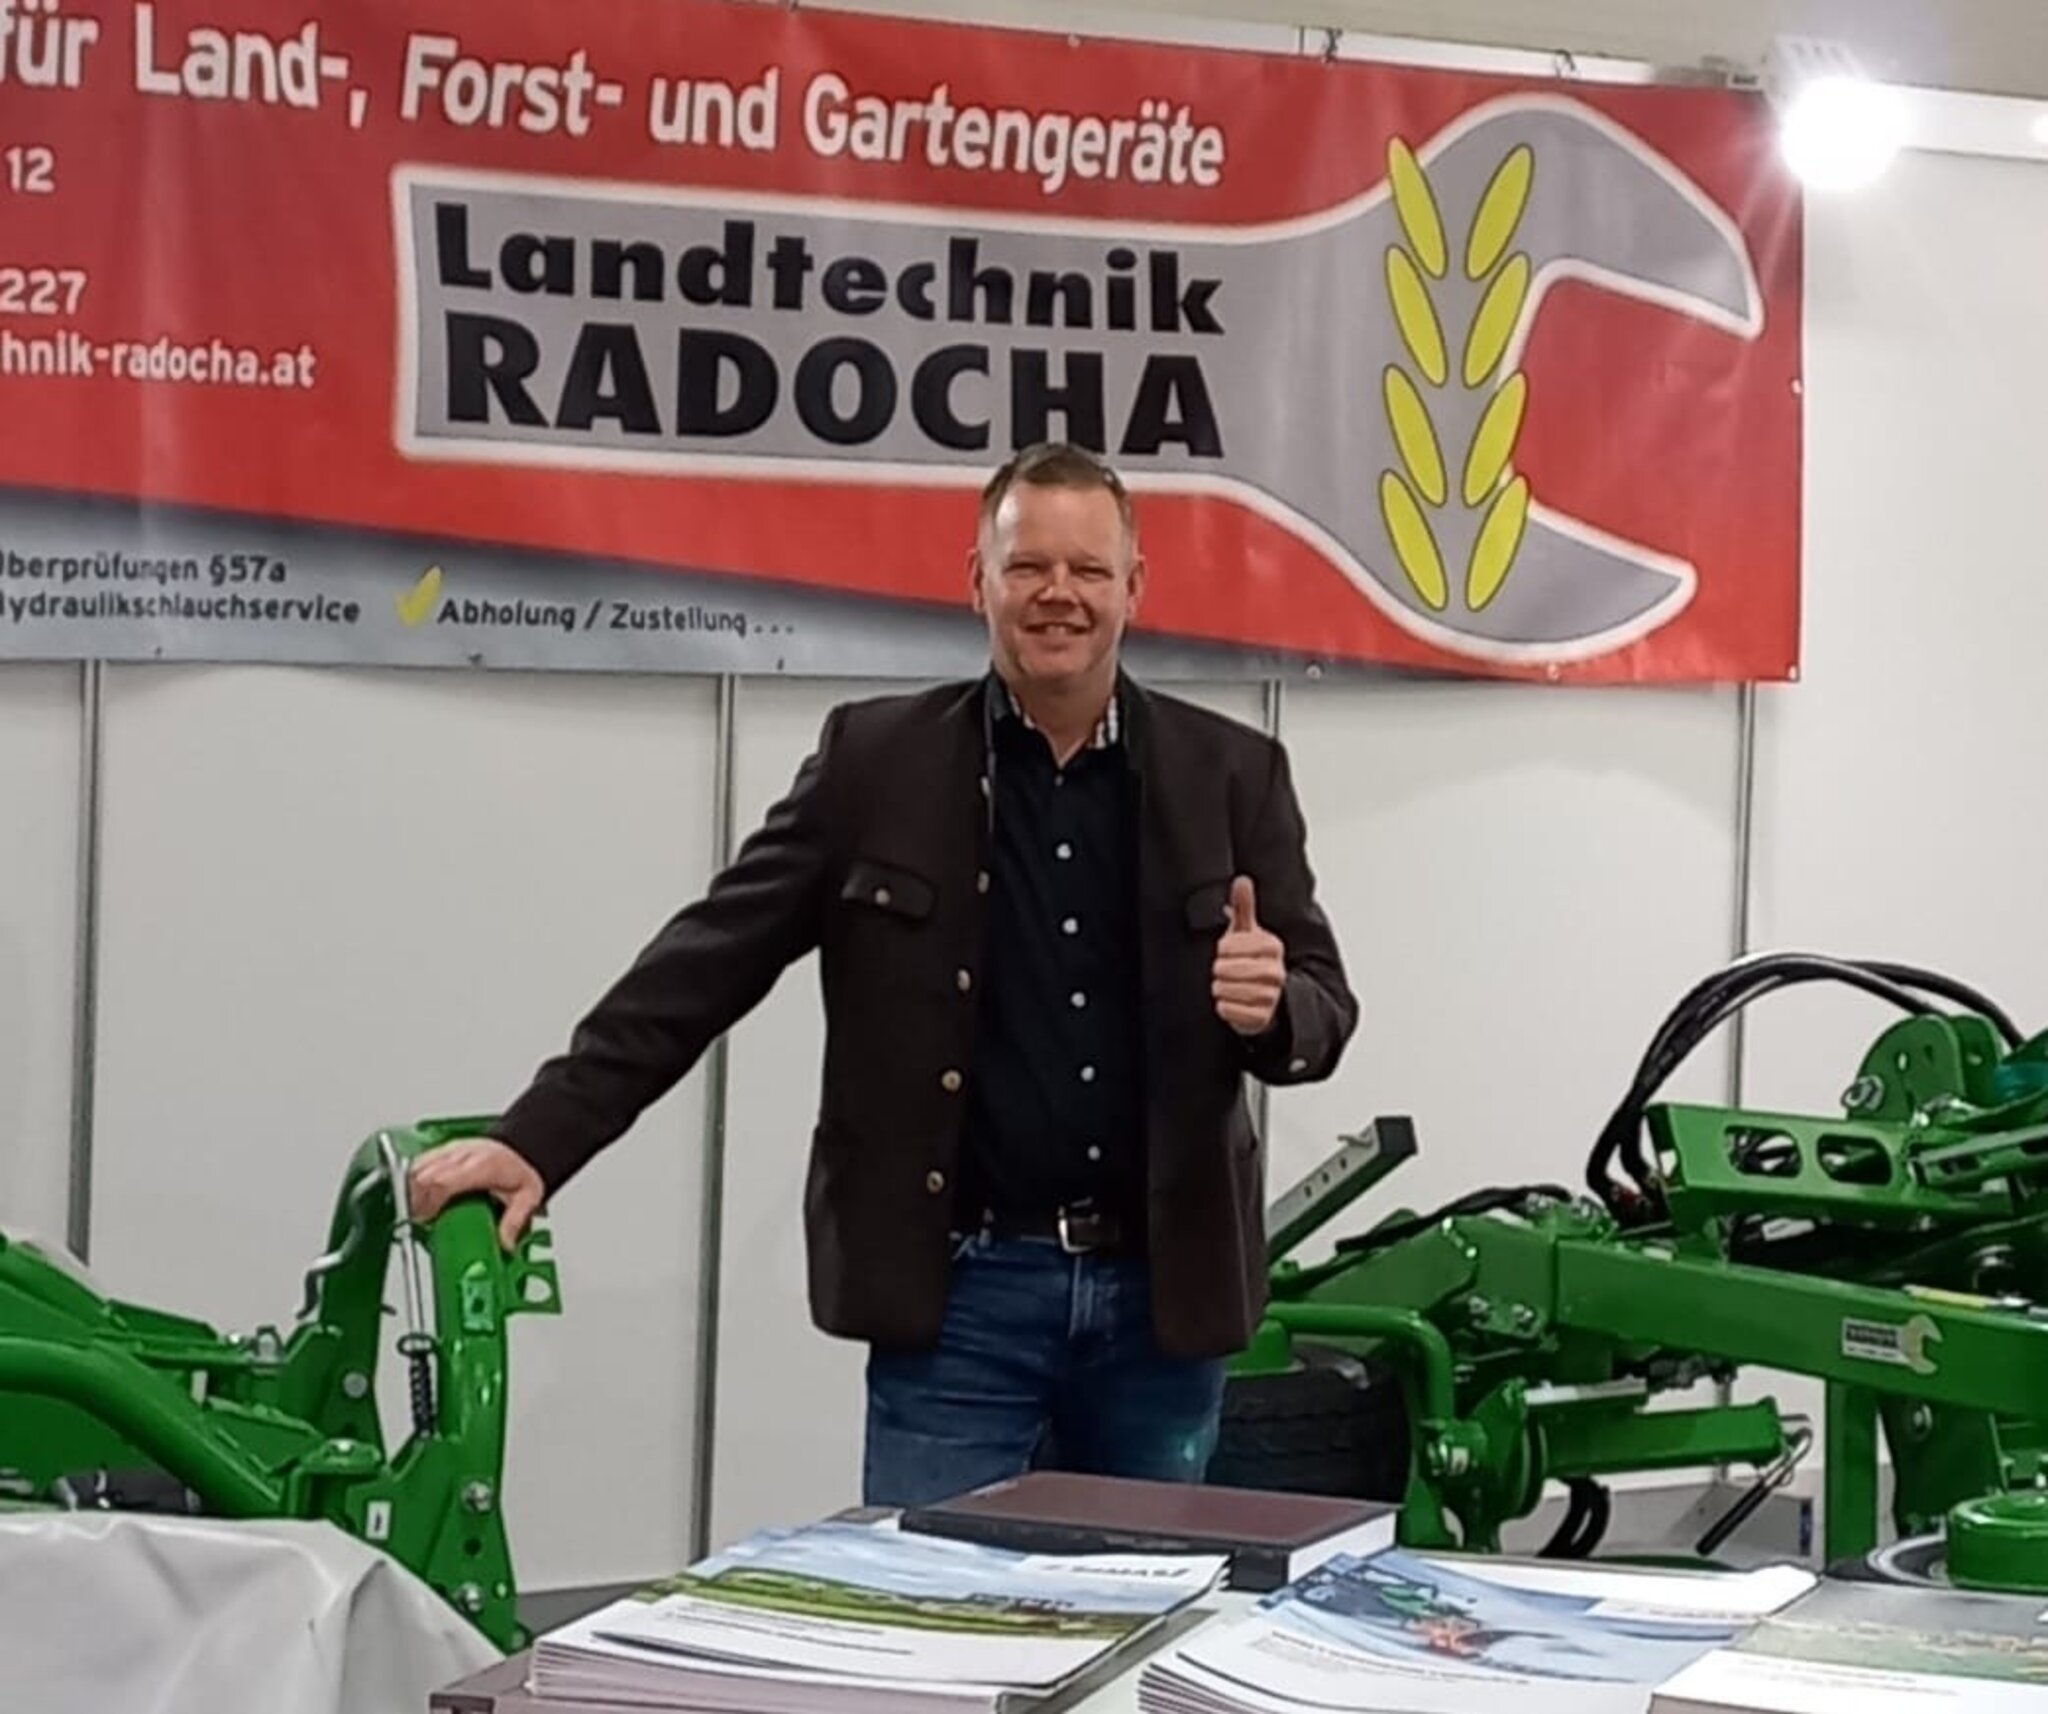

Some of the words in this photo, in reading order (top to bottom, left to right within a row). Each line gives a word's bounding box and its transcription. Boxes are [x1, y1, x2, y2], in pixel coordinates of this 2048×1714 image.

[136, 3, 367, 129] Land-,
[401, 34, 623, 136] Forst-
[649, 67, 780, 150] und
[804, 73, 1224, 193] Gartengeräte
[6, 147, 55, 192] 12
[0, 268, 87, 314] 227
[435, 201, 1224, 334] Landtechnik
[2, 330, 315, 388] hnik-radocha.at
[445, 310, 1223, 462] RADOCHA
[208, 554, 287, 586] §57a
[437, 599, 576, 632] Abholung
